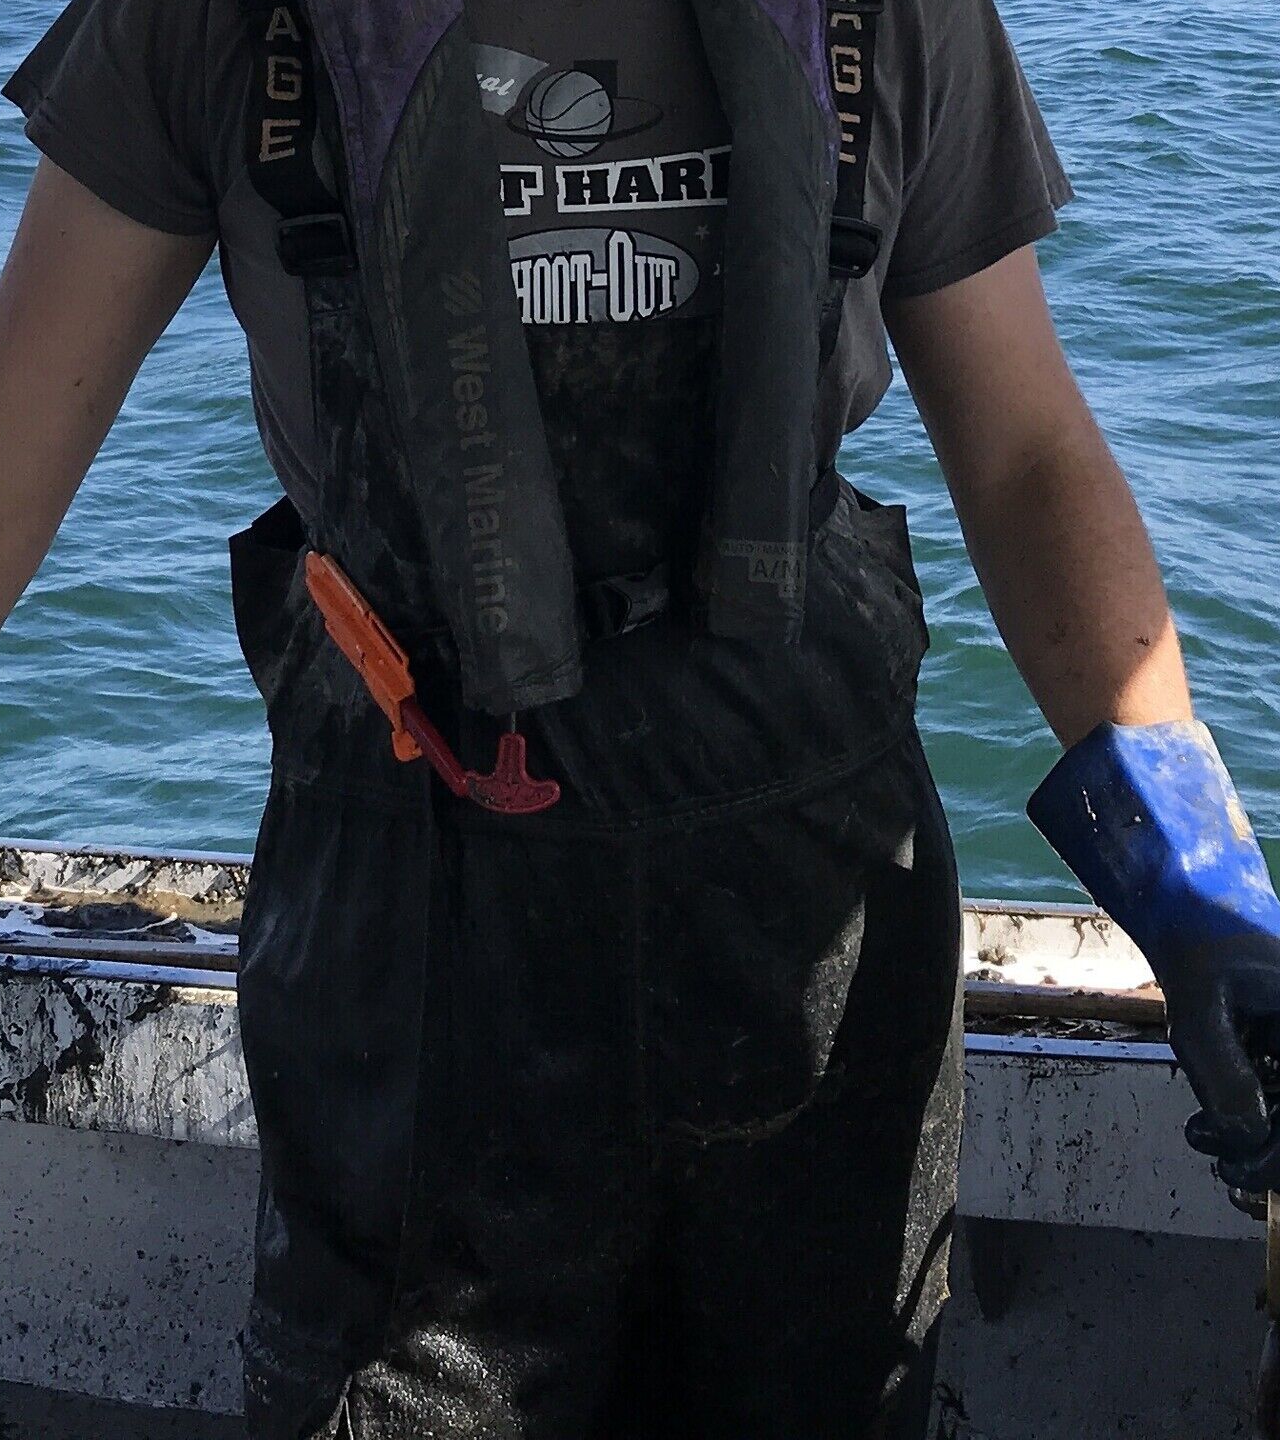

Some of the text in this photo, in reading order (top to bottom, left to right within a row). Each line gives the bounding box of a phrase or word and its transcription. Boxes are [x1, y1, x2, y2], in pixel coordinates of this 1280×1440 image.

[476, 73, 515, 96] al
[447, 324, 513, 636] West Marine
[752, 558, 801, 579] A/M
